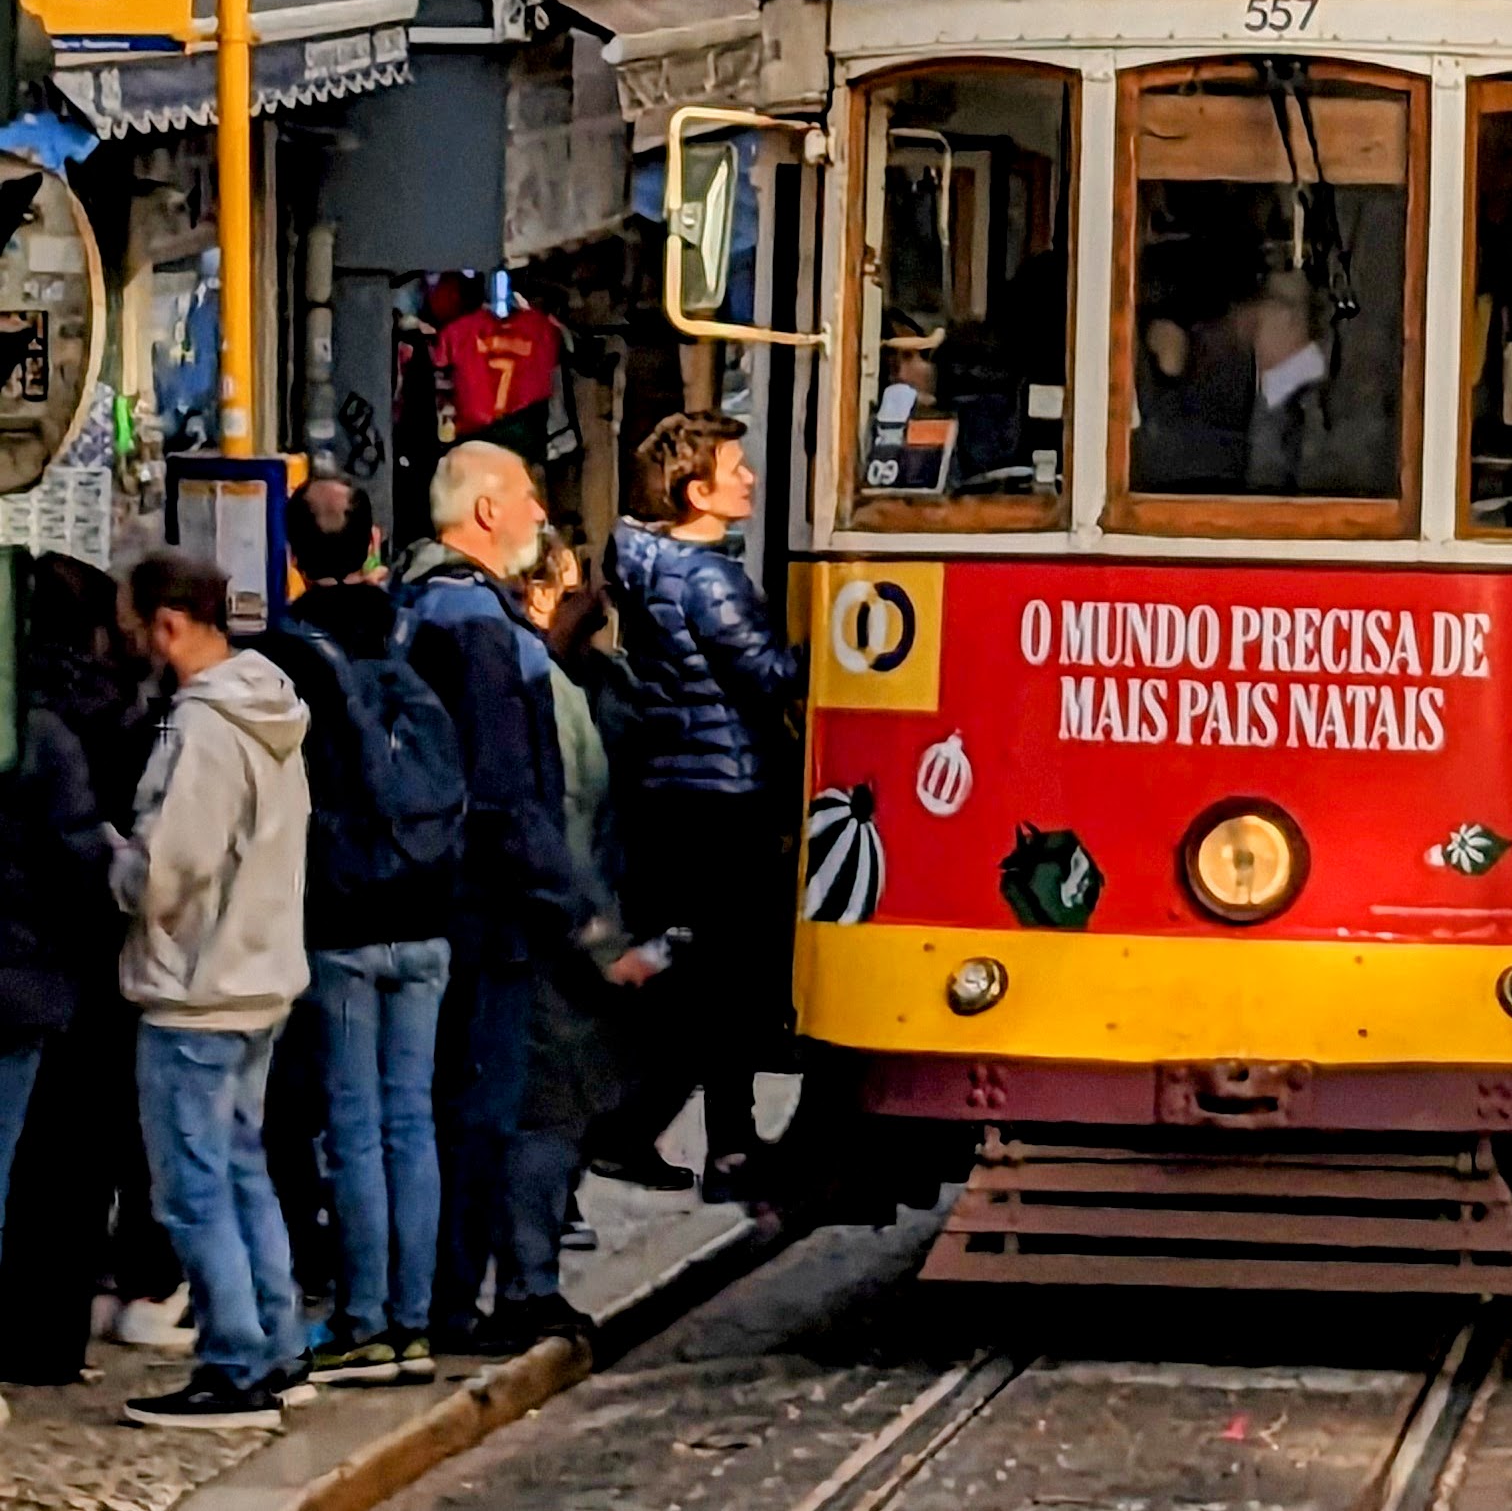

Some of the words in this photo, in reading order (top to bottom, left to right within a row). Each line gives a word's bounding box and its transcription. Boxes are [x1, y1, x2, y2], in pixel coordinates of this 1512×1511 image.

[488, 358, 515, 411] 7
[1020, 599, 1051, 666] O
[1058, 600, 1221, 669] MUNDO
[1228, 605, 1423, 676] PRECISA
[1430, 611, 1491, 678] DE
[1058, 675, 1169, 745] MAIS
[1175, 679, 1279, 749] PAIS
[1286, 683, 1446, 751] NATAIS
